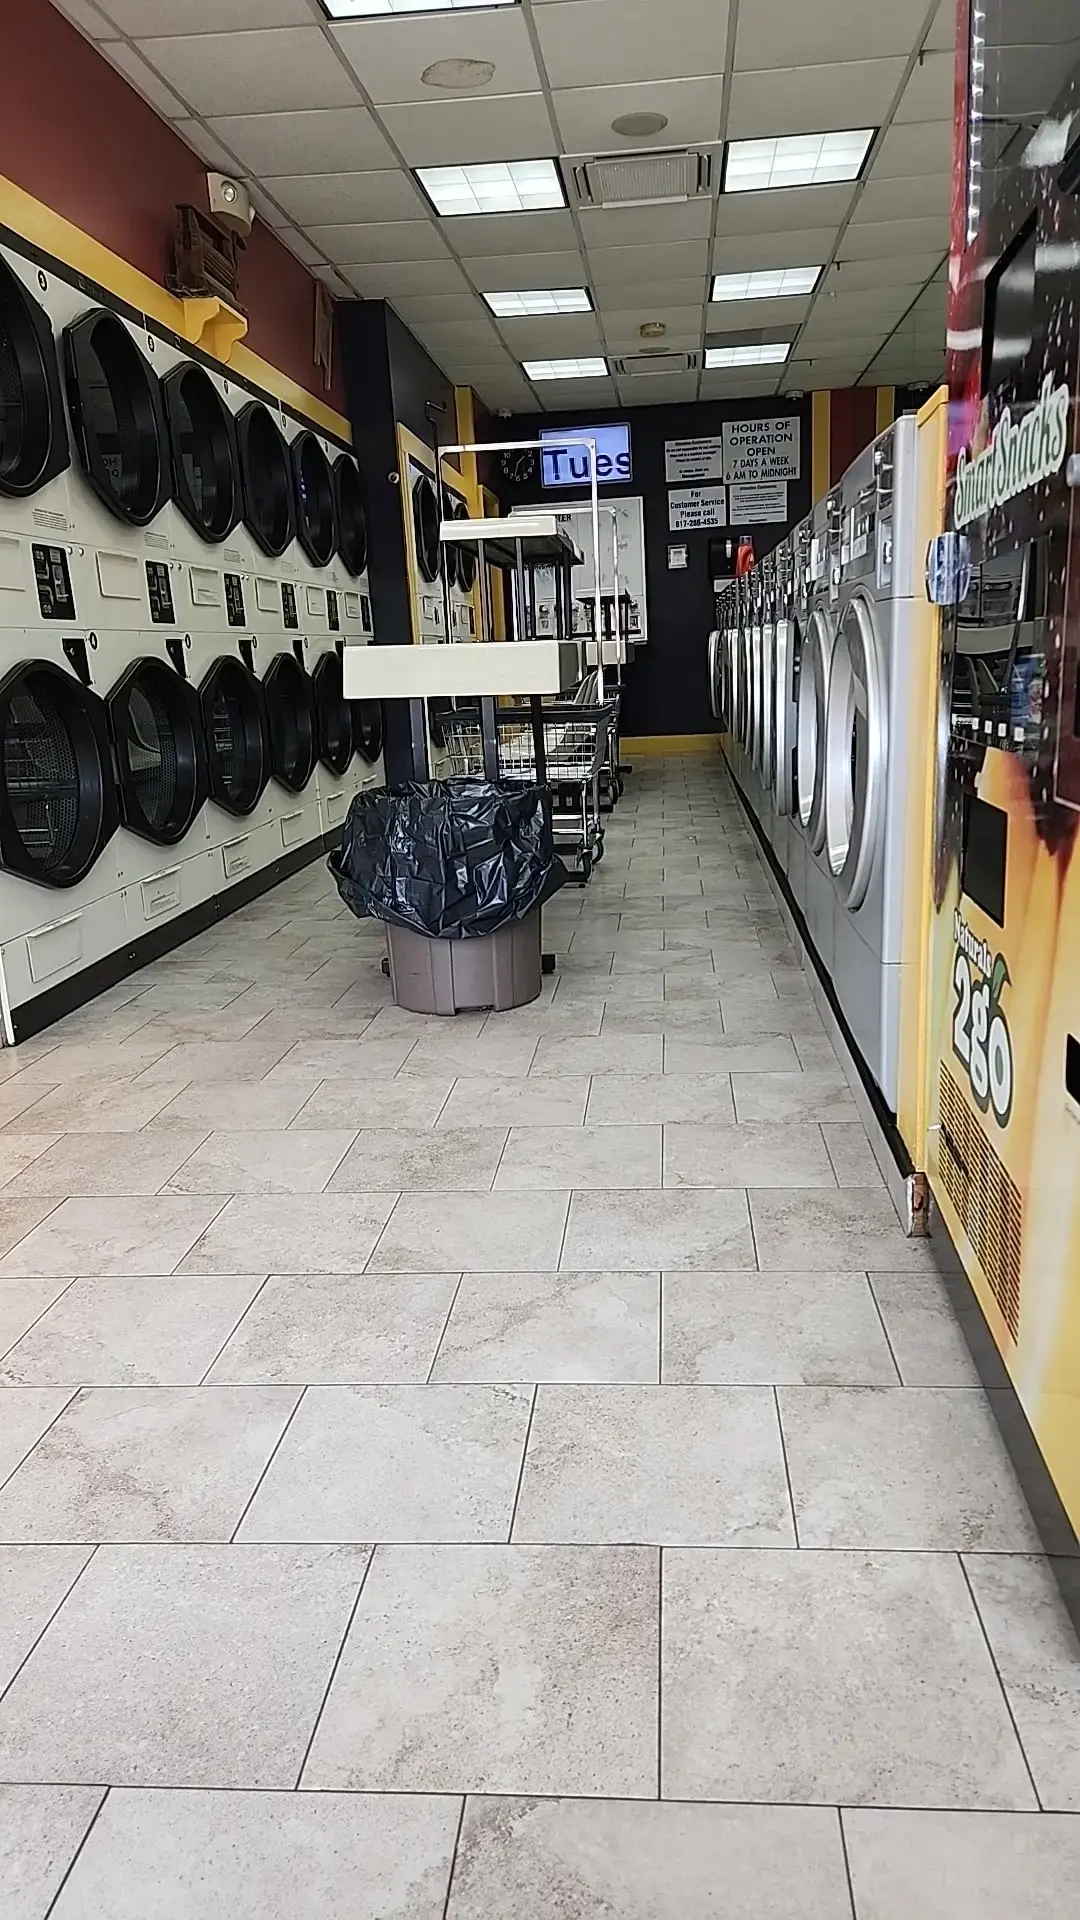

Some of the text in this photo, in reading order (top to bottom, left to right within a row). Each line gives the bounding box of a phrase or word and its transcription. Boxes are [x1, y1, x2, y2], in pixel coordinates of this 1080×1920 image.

[731, 421, 791, 434] HOURS OF
[729, 432, 793, 446] OPERATION
[527, 450, 533, 458] 2
[747, 446, 776, 457] OPEN
[544, 449, 630, 480] Tues
[732, 456, 790, 469] 7 DAYS A WEEK
[503, 466, 509, 474] 8
[527, 466, 533, 474] 4
[725, 466, 797, 481] 6 AM TO MIDNIGHT
[523, 472, 529, 480] 5
[690, 490, 702, 498] For
[670, 500, 700, 510] Customer
[700, 498, 725, 507] Service
[555, 513, 572, 523] TER
[680, 507, 715, 518] Please call
[953, 908, 993, 979] Naturals
